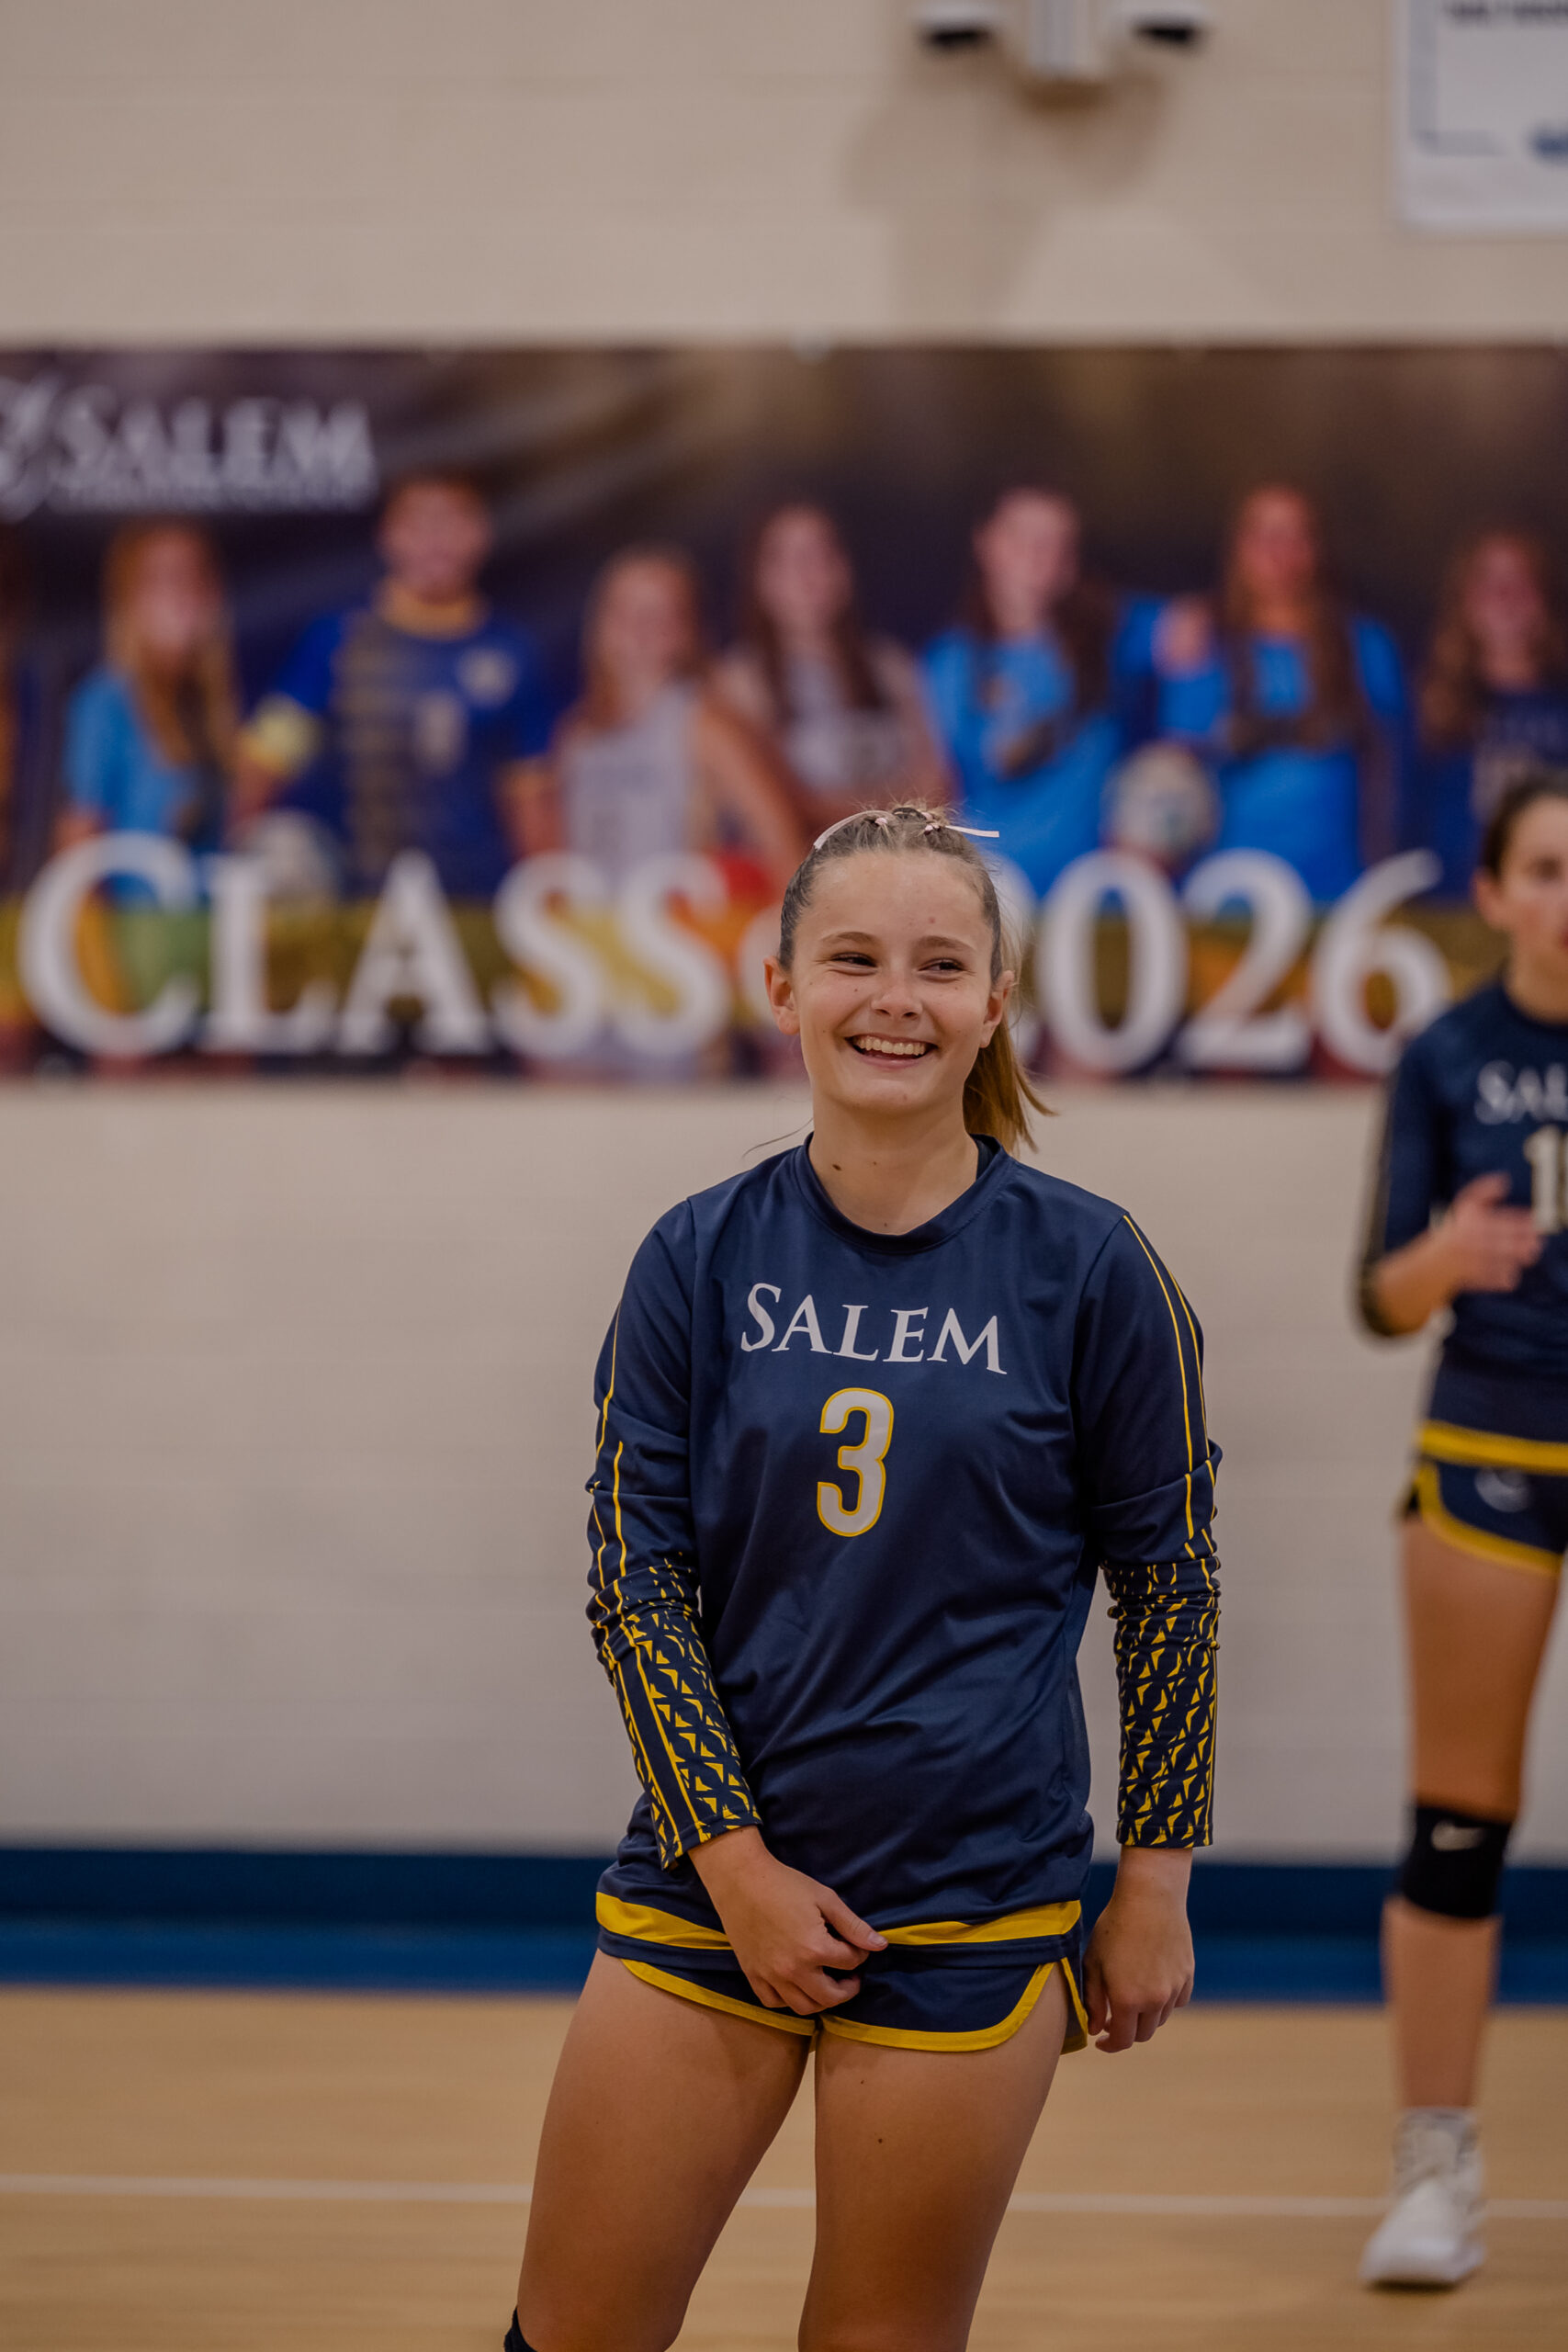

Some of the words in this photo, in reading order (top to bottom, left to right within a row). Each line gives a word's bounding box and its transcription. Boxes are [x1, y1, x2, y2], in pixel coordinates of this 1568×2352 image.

[18, 832, 729, 1058] CLASS
[994, 847, 1451, 1076] 026
[1523, 1125, 1568, 1237] 1
[740, 1283, 1008, 1375] SALEM
[816, 1387, 895, 1537] 3
